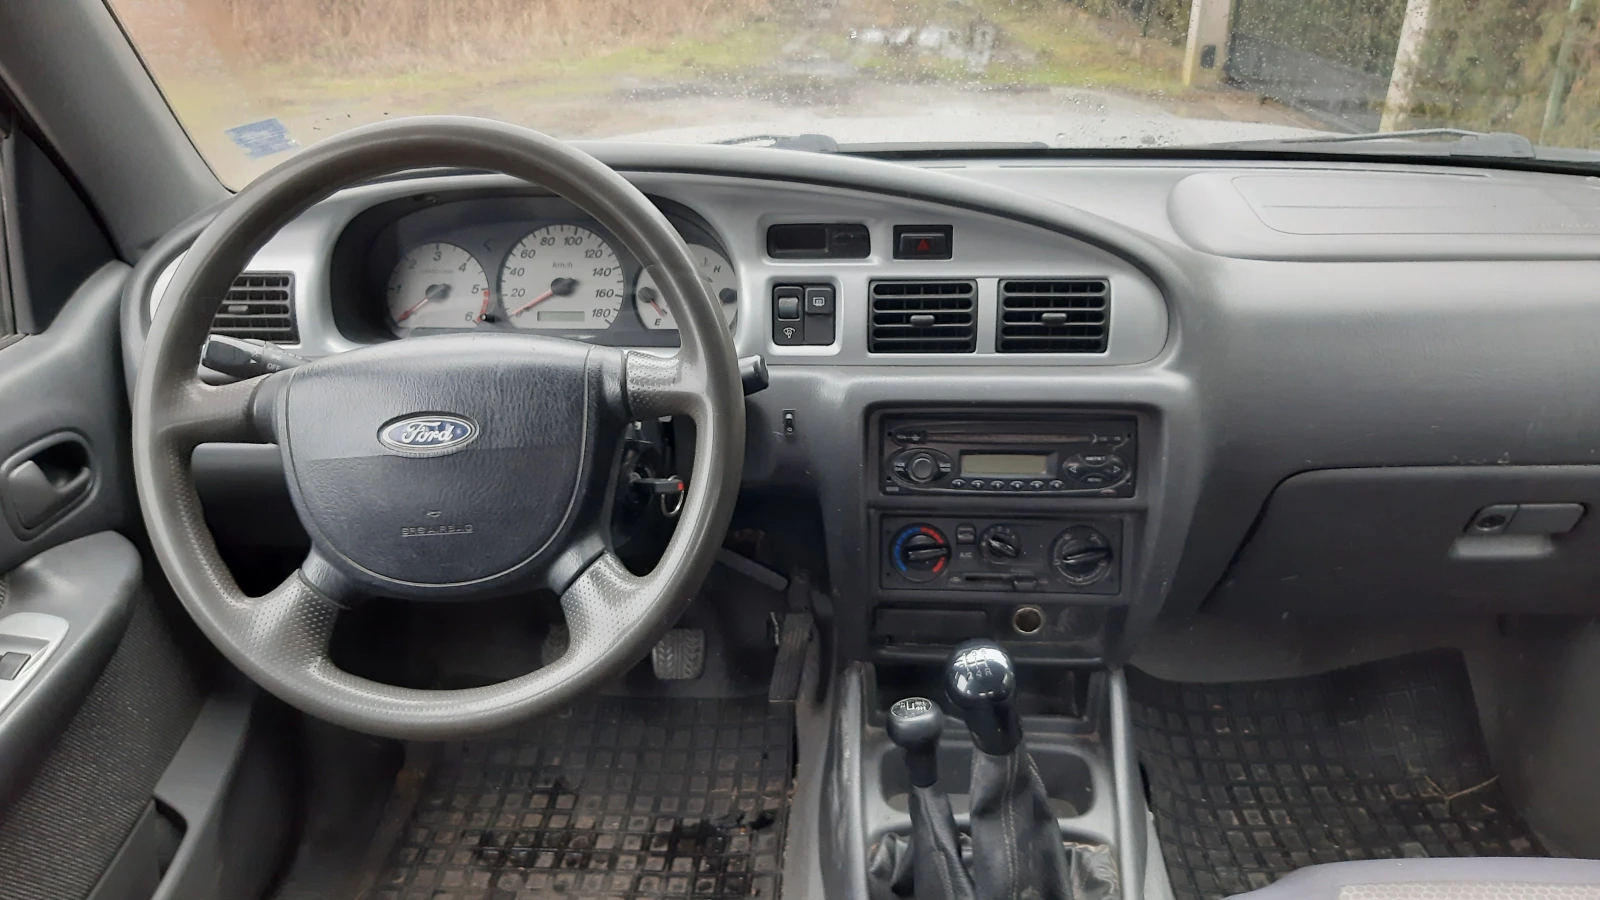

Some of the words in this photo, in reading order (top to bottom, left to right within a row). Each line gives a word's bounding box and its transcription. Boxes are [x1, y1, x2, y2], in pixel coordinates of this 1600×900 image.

[540, 237, 555, 246] 80
[563, 237, 583, 246] 100
[433, 251, 442, 261] 3
[520, 249, 536, 258] 60
[584, 249, 603, 258] 120
[408, 260, 417, 269] 2
[458, 262, 467, 272] 4
[713, 265, 721, 273] H
[509, 267, 525, 276] 40
[592, 268, 612, 277] 140
[471, 284, 480, 294] 5
[510, 288, 526, 297] 20
[595, 289, 614, 298] 160
[465, 311, 474, 321] 6
[592, 309, 611, 318] 180
[654, 318, 662, 326] E
[401, 421, 455, 443] Ford
[984, 667, 992, 676] R
